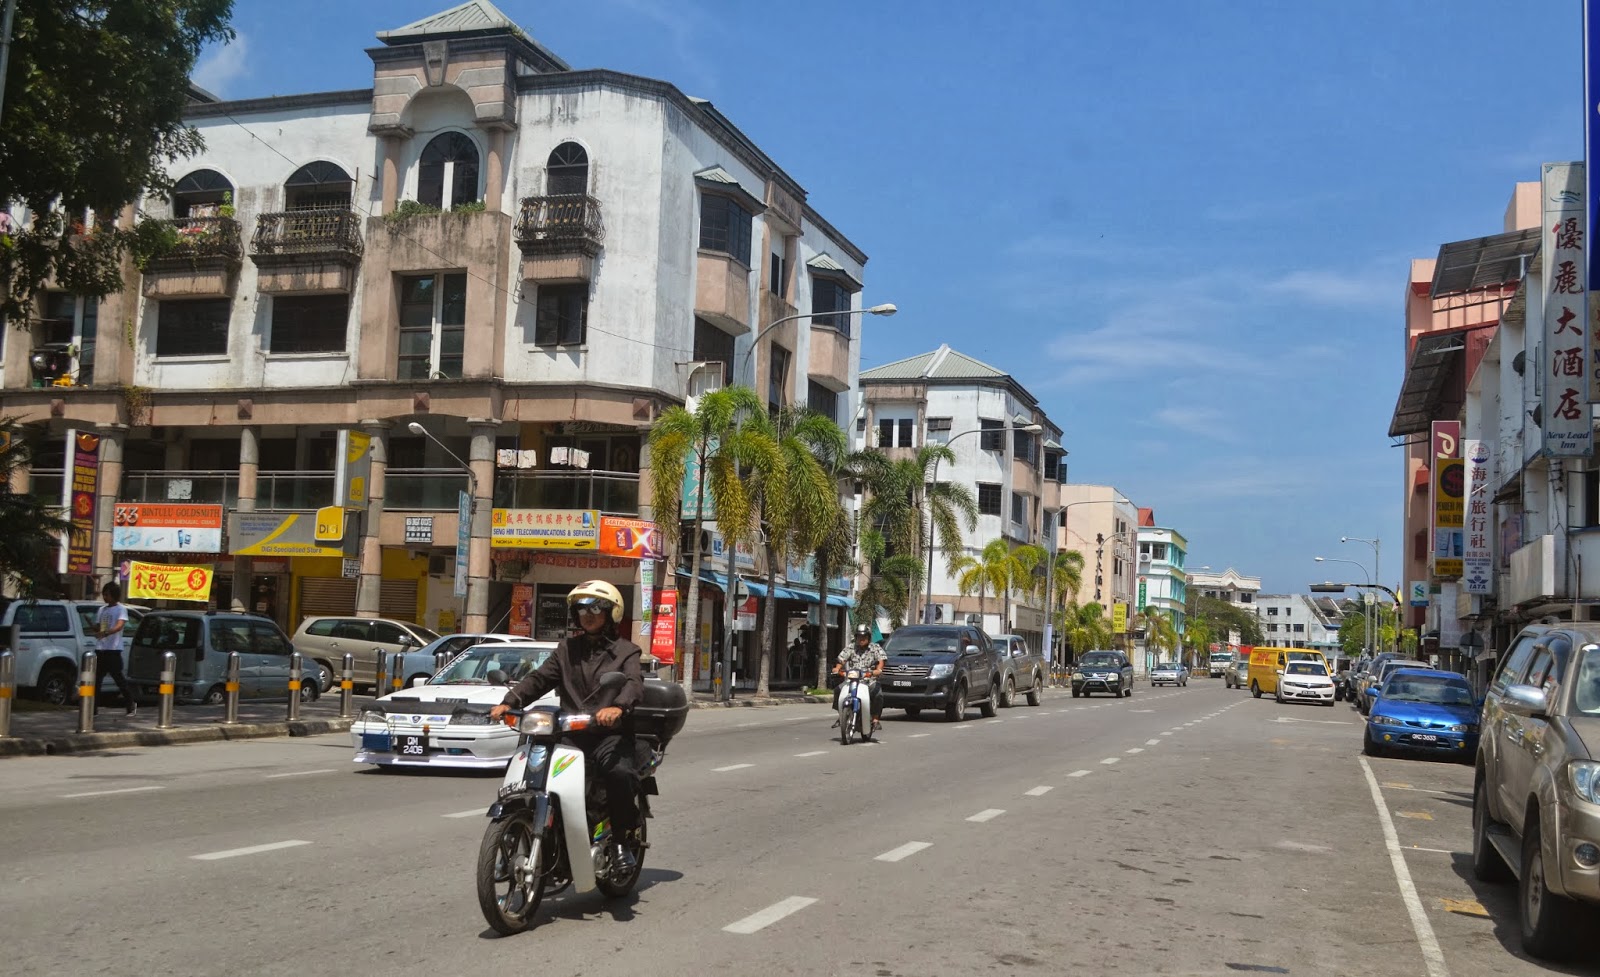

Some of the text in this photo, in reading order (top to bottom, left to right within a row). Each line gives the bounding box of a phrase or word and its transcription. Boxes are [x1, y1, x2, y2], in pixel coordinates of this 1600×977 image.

[1552, 218, 1584, 420] 優麗大酒店
[1561, 441, 1576, 449] Inn
[141, 507, 220, 518] BINTULU GOLDSMITH
[1470, 467, 1487, 549] 海外旅行社
[116, 507, 139, 525] 33
[573, 529, 594, 537] SERVICES
[135, 572, 170, 591] 1.5%
[407, 736, 418, 745] QM
[403, 745, 423, 754] 2406
